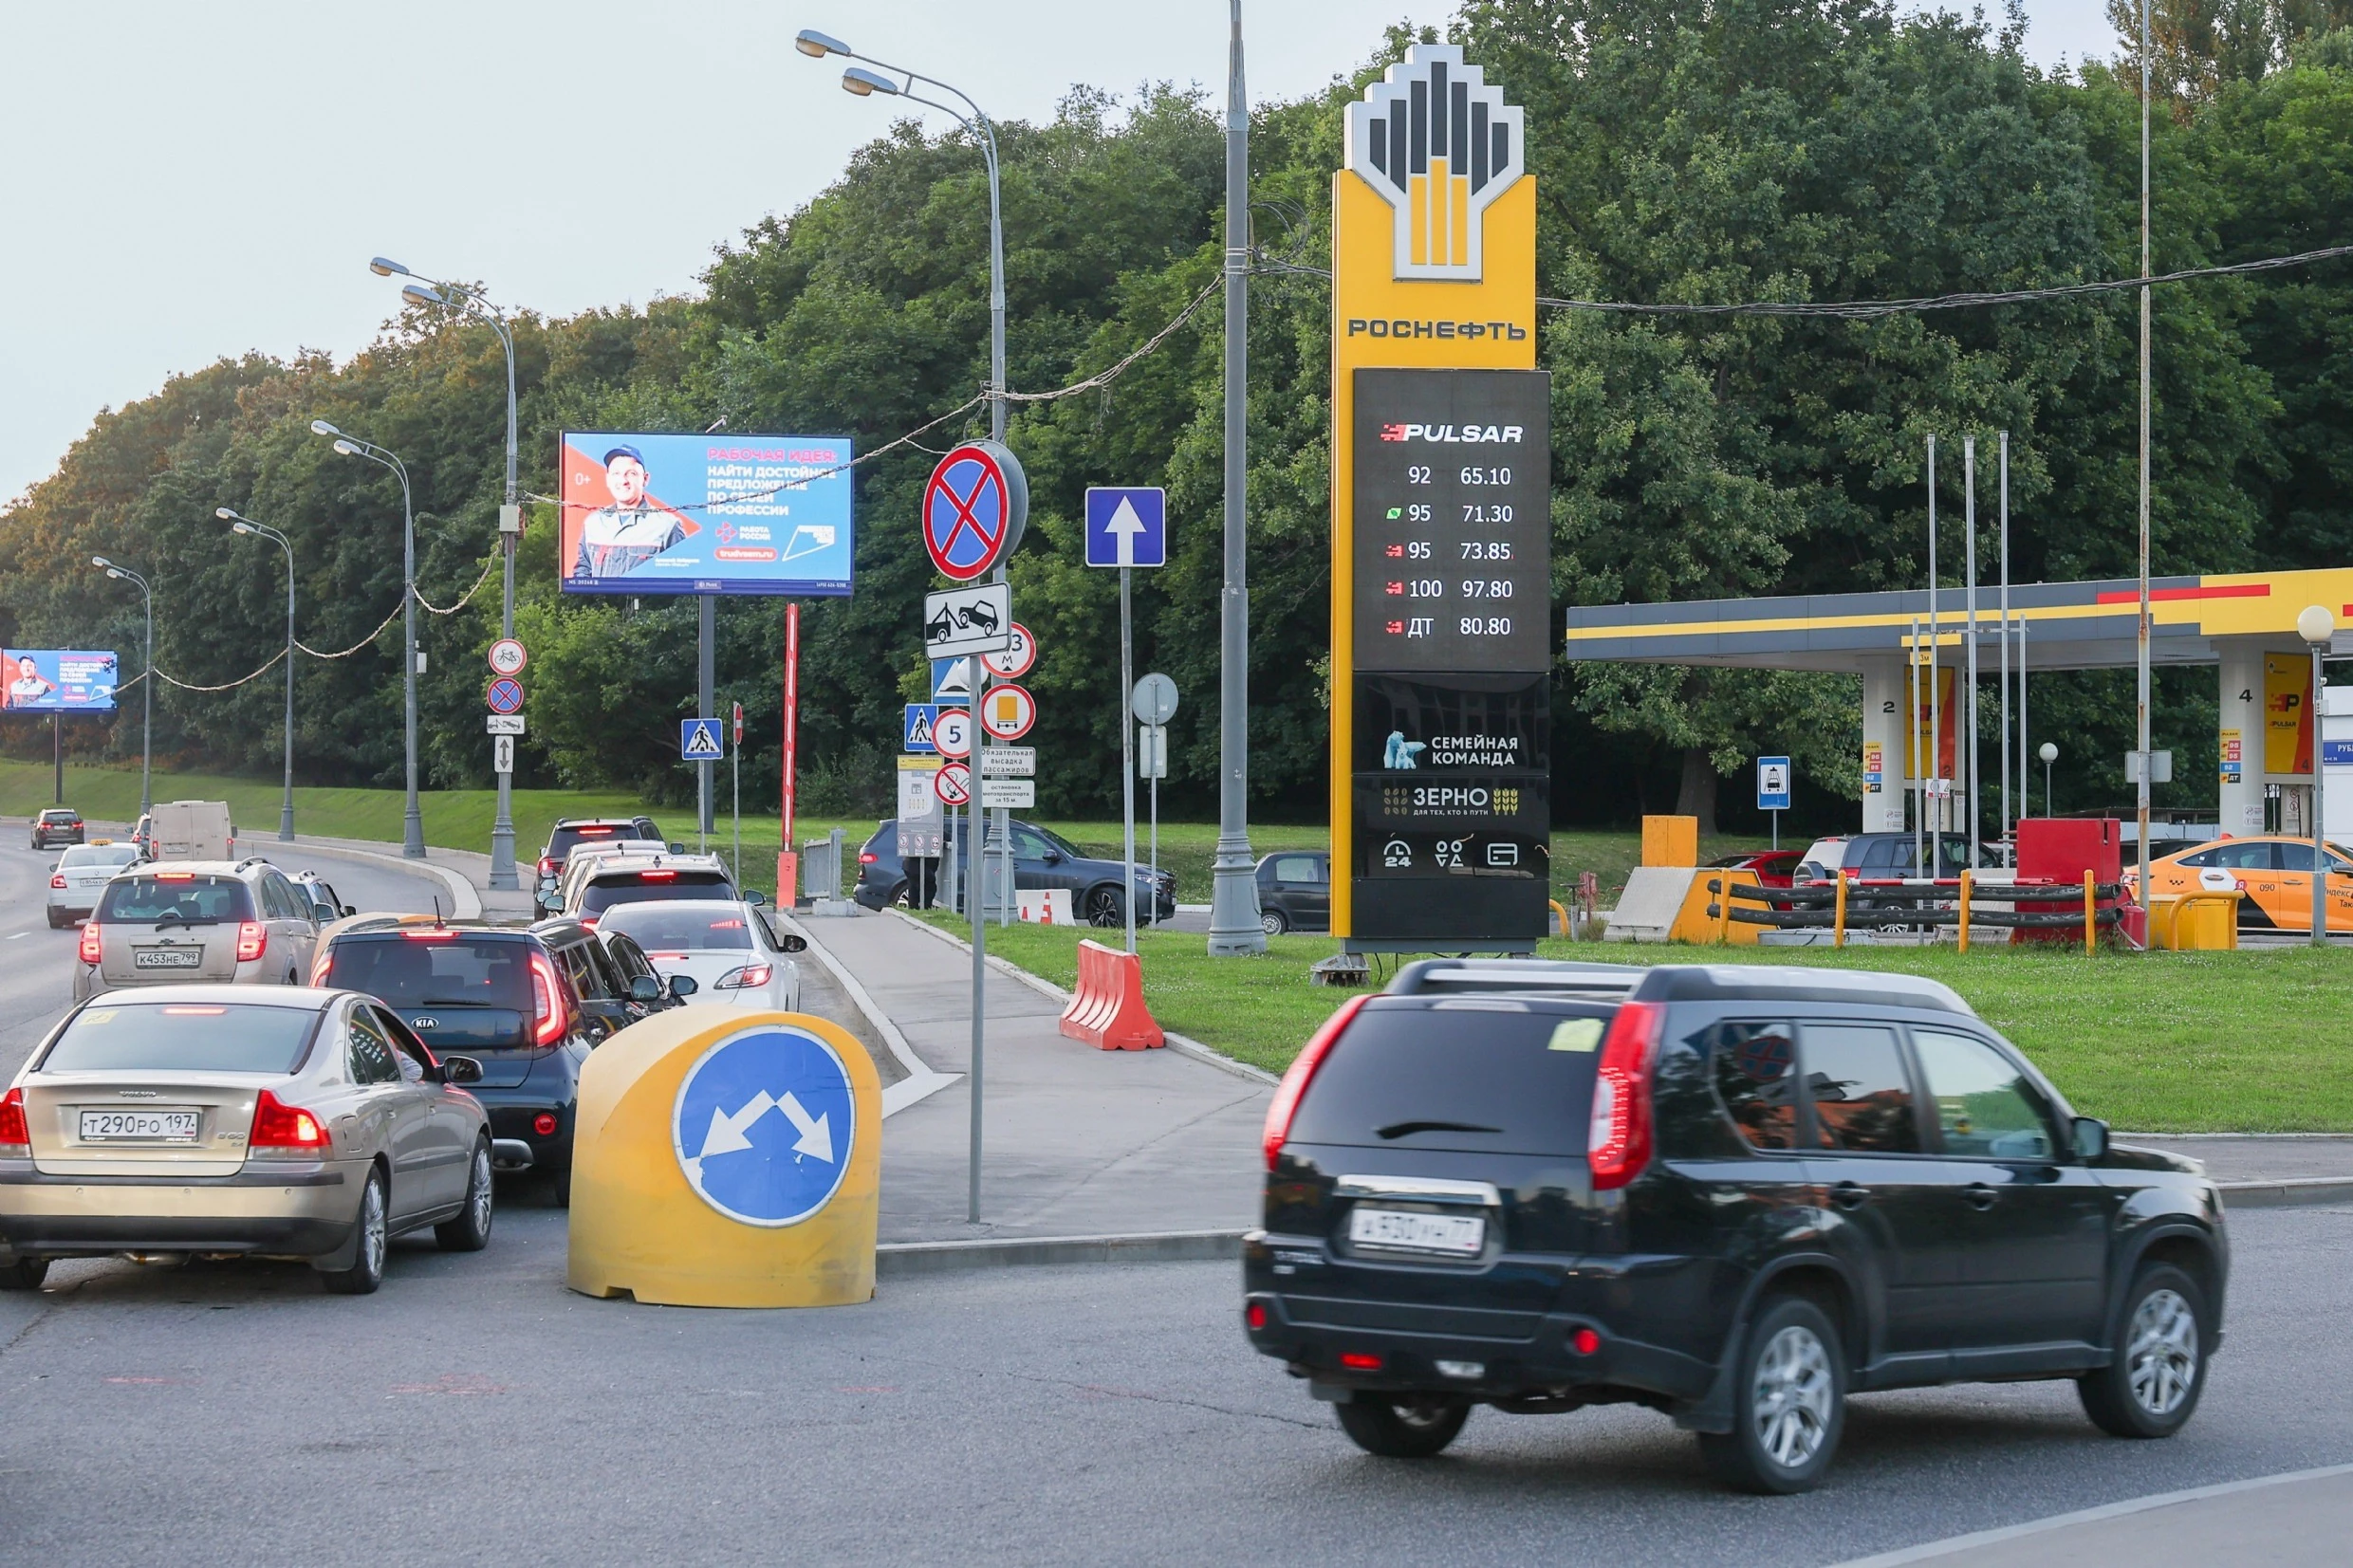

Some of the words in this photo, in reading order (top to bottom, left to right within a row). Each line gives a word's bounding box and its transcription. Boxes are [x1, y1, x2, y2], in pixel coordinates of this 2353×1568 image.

[1348, 319, 1527, 341] РОСНЕФТЬ
[1403, 424, 1524, 443] PULSAR
[708, 448, 785, 462] РАБОЧАЯ
[788, 450, 838, 464] ИДЕЯ:
[575, 471, 591, 486] 0+
[707, 464, 752, 477] НАЙТИ
[755, 466, 837, 479] ДОСТОЙНОЕ
[1408, 467, 1431, 485] 92
[1460, 468, 1511, 486] 65.10
[707, 490, 728, 503] ПО
[707, 504, 789, 516] ПРОФЕССИИ
[1408, 505, 1431, 522] 95
[1463, 506, 1512, 523] 71.30
[1408, 542, 1431, 560] 95
[1460, 543, 1510, 560] 73.85
[1409, 581, 1442, 598] 100
[1462, 581, 1512, 598] 97.80
[1407, 618, 1434, 638] ДТ
[1459, 618, 1510, 635] 80.80
[2239, 690, 2252, 703] 4
[1883, 701, 1895, 713] 2
[950, 726, 961, 744] 5
[1432, 734, 1518, 749] СЕМЕЙНАЯ
[1433, 752, 1515, 766] КОМАНДА
[1413, 787, 1489, 806] ЗЕРНО
[1385, 857, 1411, 867] 24
[2259, 884, 2275, 893] 090
[2325, 888, 2350, 897] ндекс
[139, 953, 179, 965] К453НЕ
[181, 952, 196, 961] 799
[416, 1019, 435, 1028] KIA
[89, 1116, 160, 1134] Т290РО
[165, 1115, 192, 1129] 197
